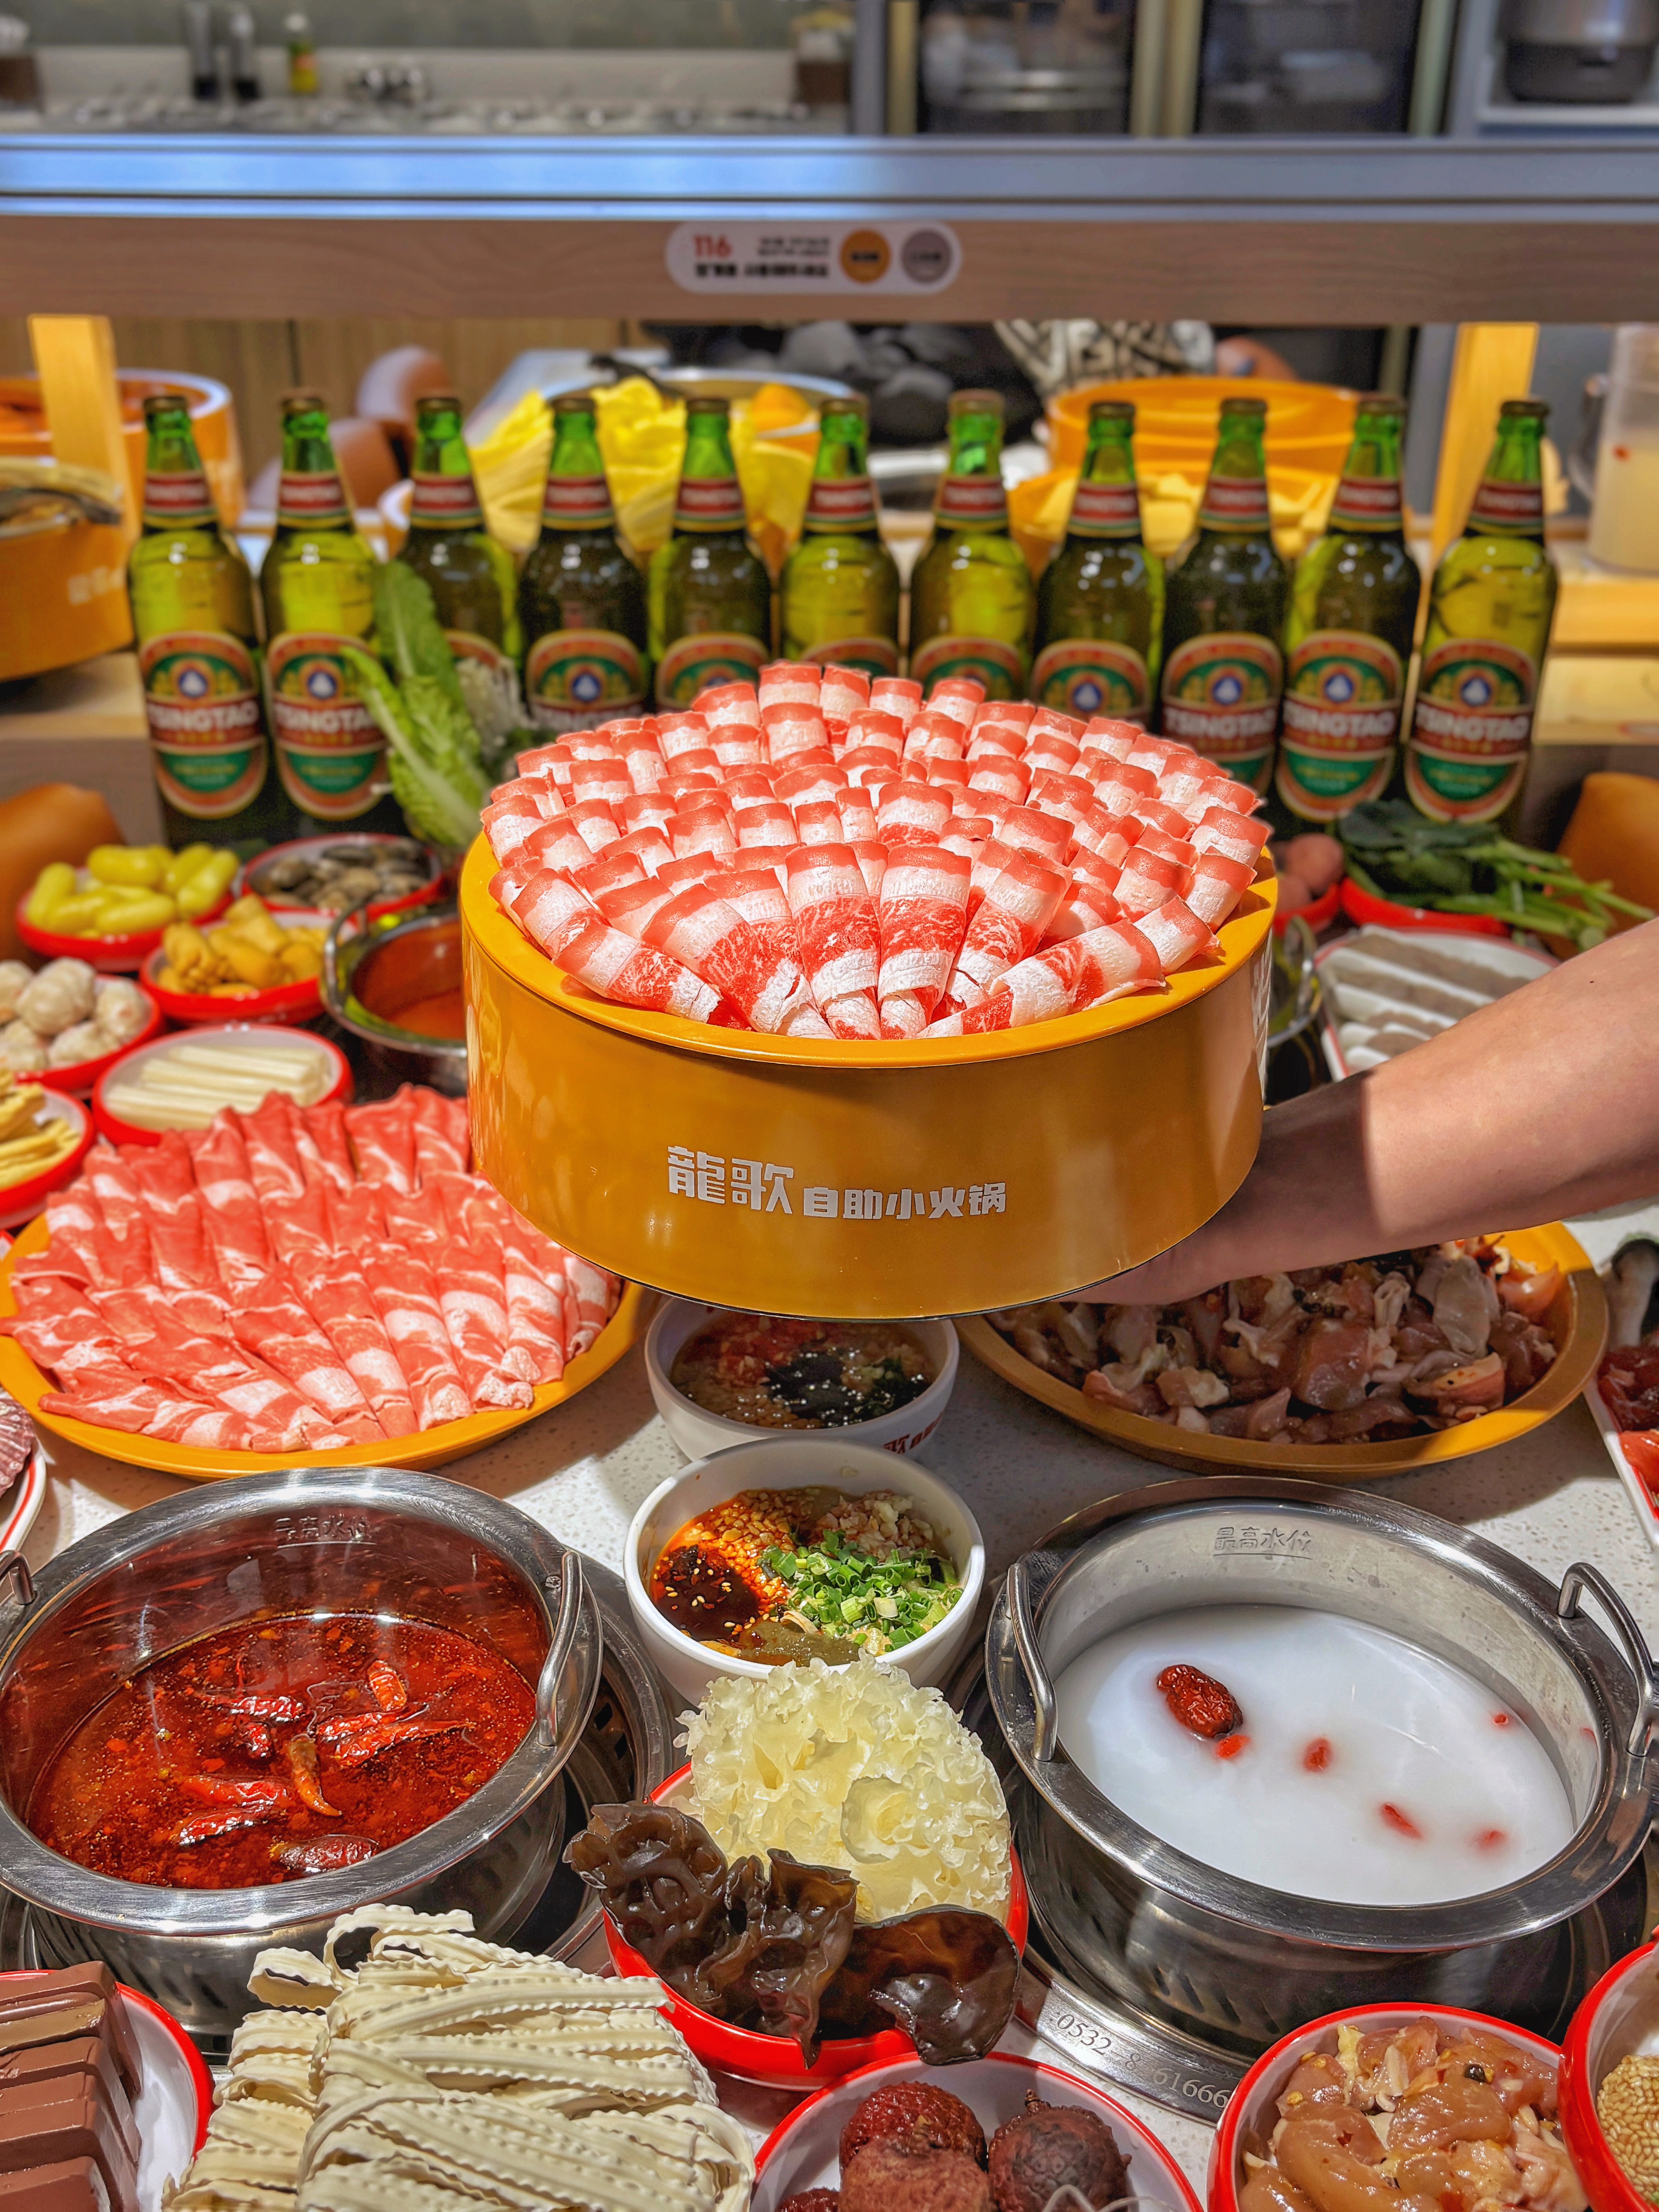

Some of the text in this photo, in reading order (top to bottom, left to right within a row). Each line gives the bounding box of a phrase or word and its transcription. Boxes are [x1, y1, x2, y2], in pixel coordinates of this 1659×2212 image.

[692, 235, 731, 258] 116
[667, 1145, 1006, 1220] 龍歌 自助小火锅
[1214, 1527, 1312, 1551] 最高水位
